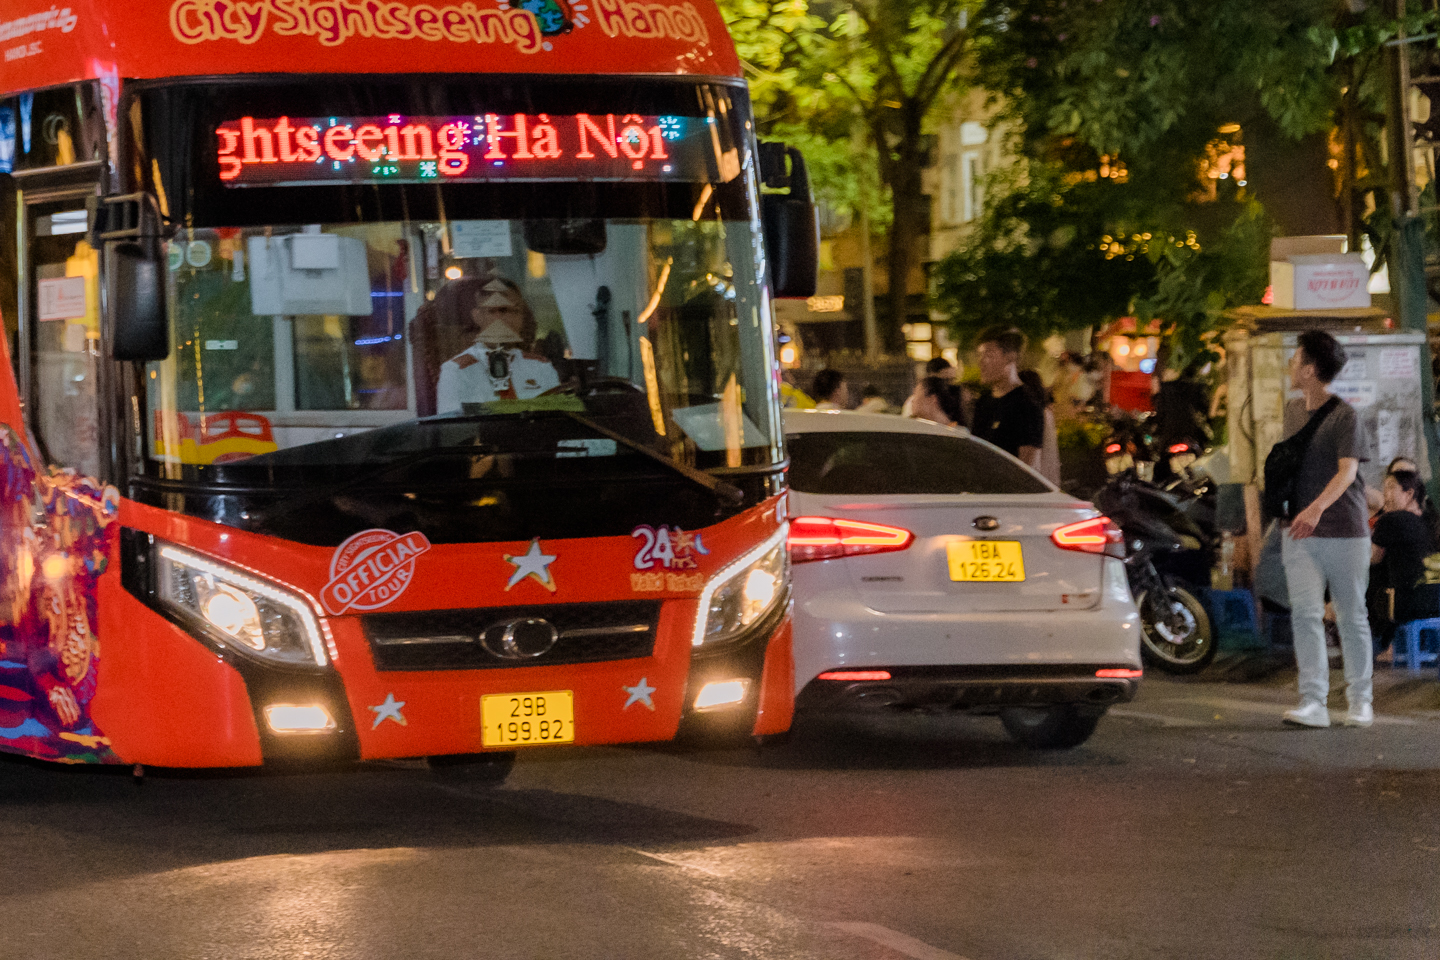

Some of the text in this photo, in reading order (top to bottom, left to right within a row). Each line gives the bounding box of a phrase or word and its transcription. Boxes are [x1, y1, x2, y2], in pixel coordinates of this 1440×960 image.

[484, 113, 562, 159] Hà
[575, 113, 668, 170] Nội
[971, 543, 1001, 559] 18A
[333, 537, 424, 603] OFFICIAL
[960, 561, 1016, 578] 126.24
[368, 568, 410, 602] TOUR
[510, 696, 546, 717] 29B
[497, 719, 563, 742] 199.82
